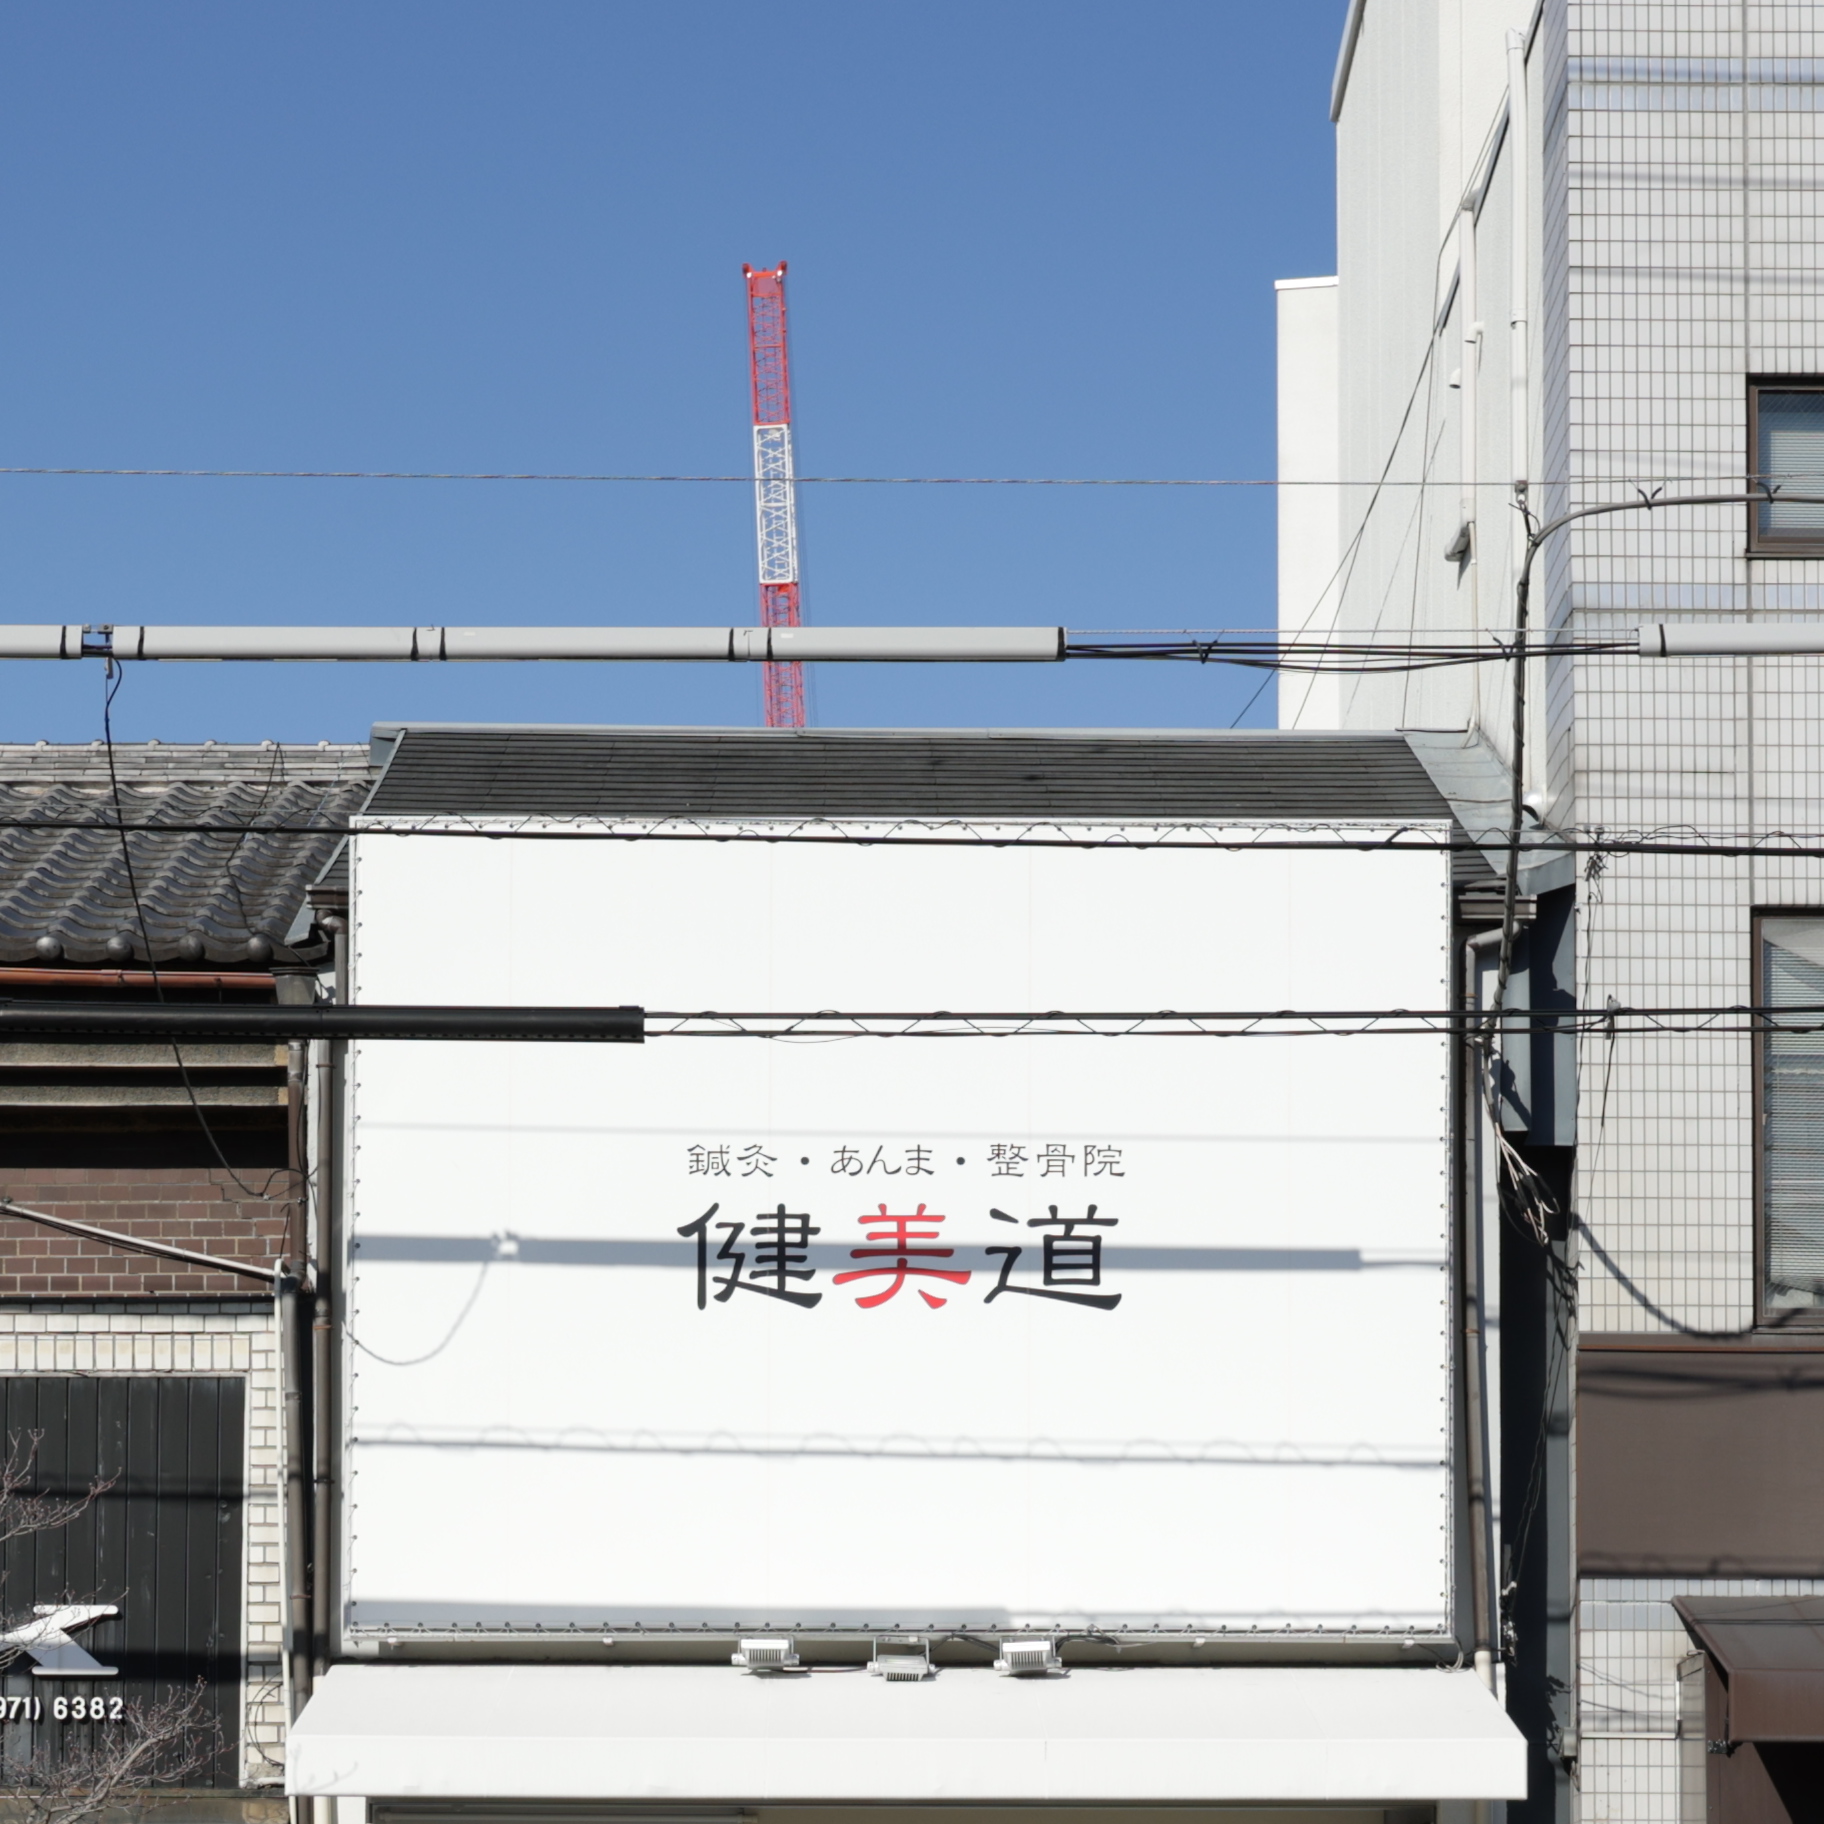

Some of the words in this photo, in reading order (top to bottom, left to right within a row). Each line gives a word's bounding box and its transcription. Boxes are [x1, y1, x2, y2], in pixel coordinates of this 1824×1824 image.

[685, 1142, 1126, 1180] 鍼灸・あんま・整骨院
[676, 1202, 1122, 1311] 健美道
[53, 1696, 125, 1723] 6382
